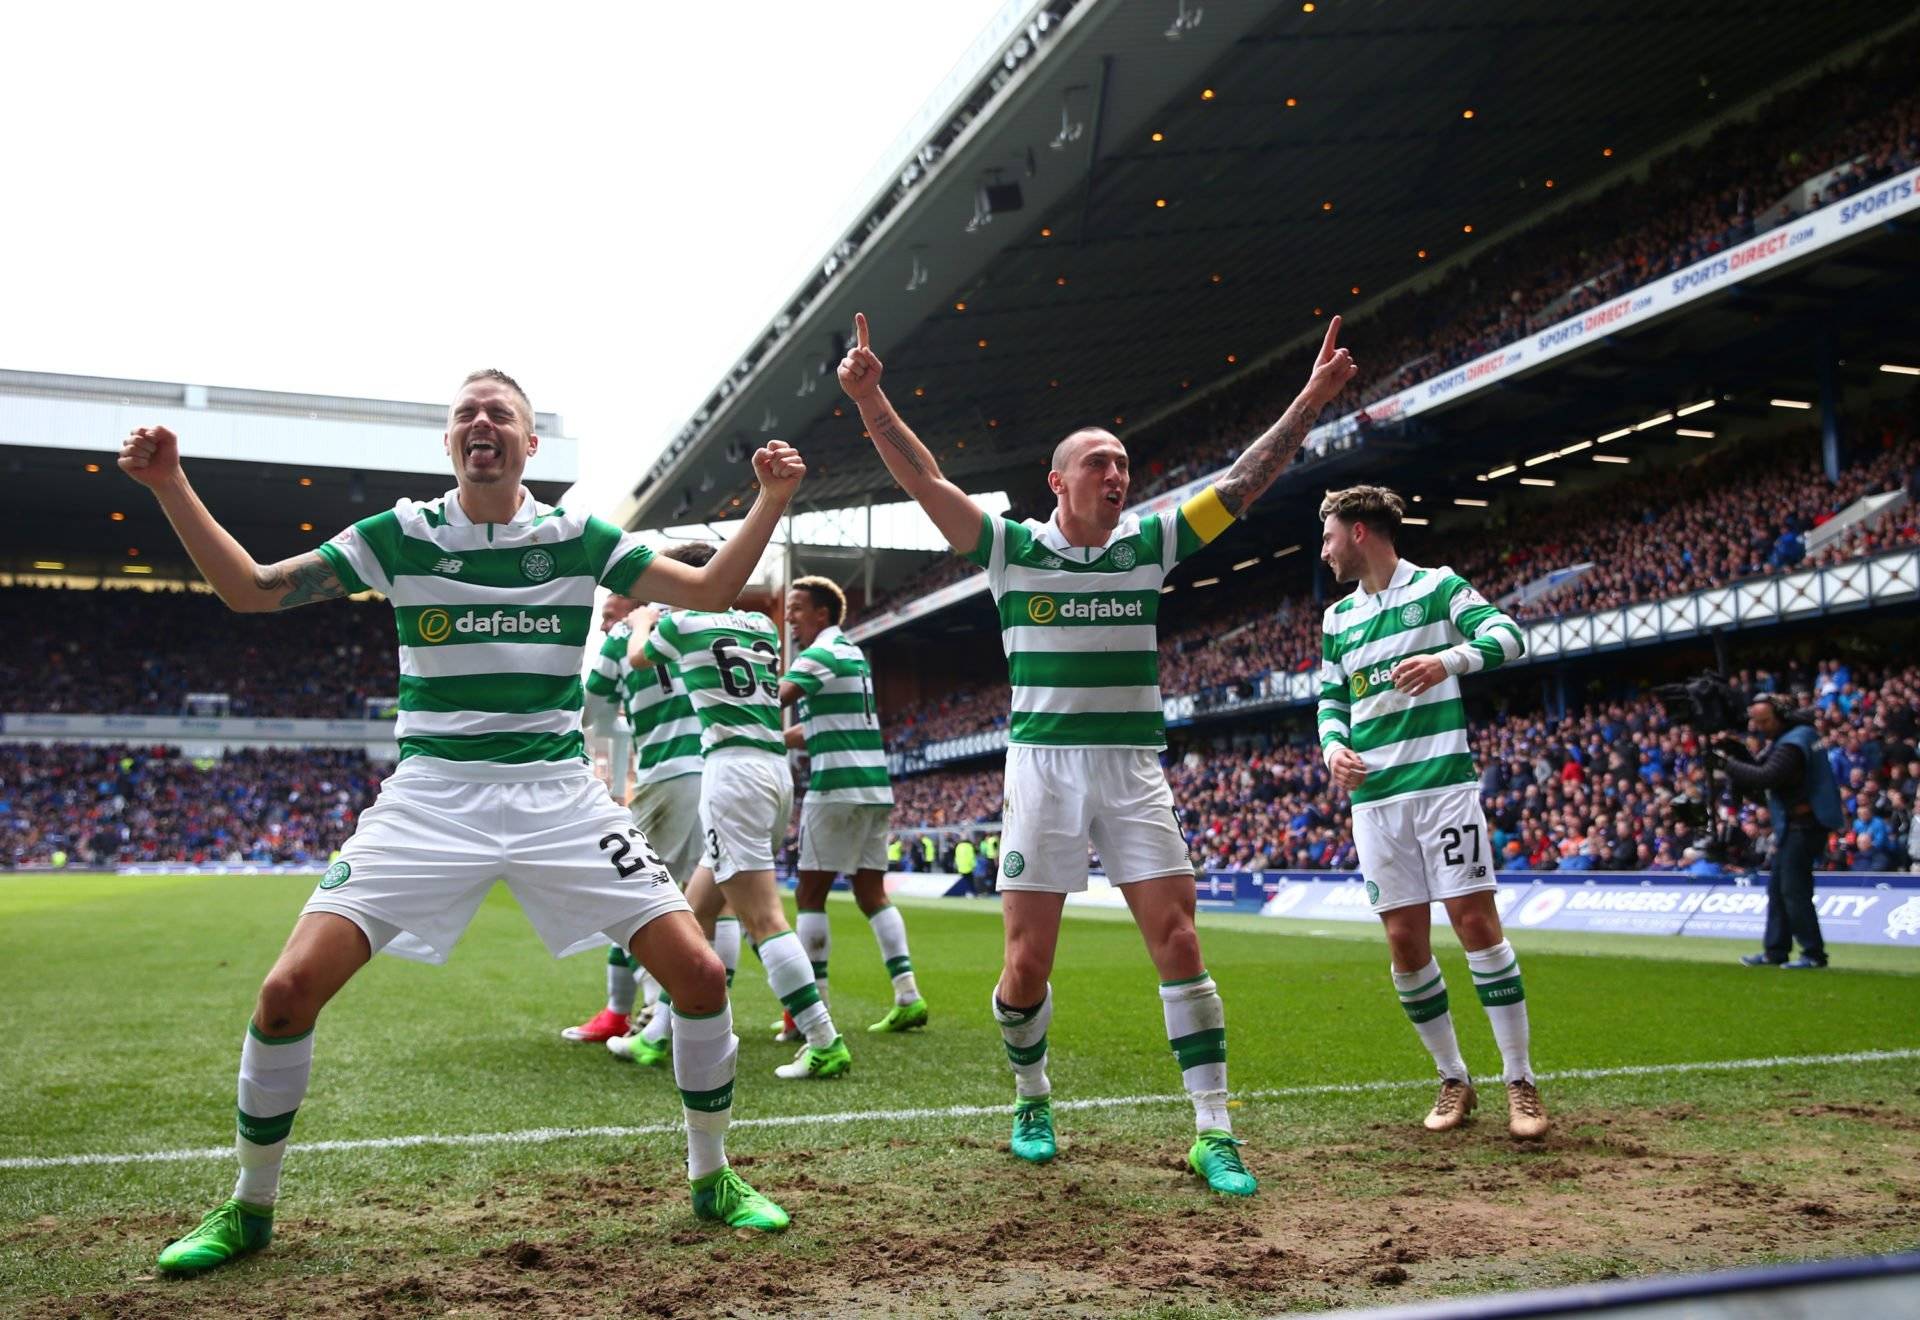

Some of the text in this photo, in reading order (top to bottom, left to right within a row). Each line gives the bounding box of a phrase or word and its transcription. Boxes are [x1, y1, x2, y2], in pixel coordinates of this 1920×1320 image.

[1060, 598, 1142, 621] dafabet
[455, 610, 561, 637] dafabet
[599, 828, 665, 879] 23
[1440, 824, 1480, 866] 27
[1566, 890, 1682, 912] RANGERS
